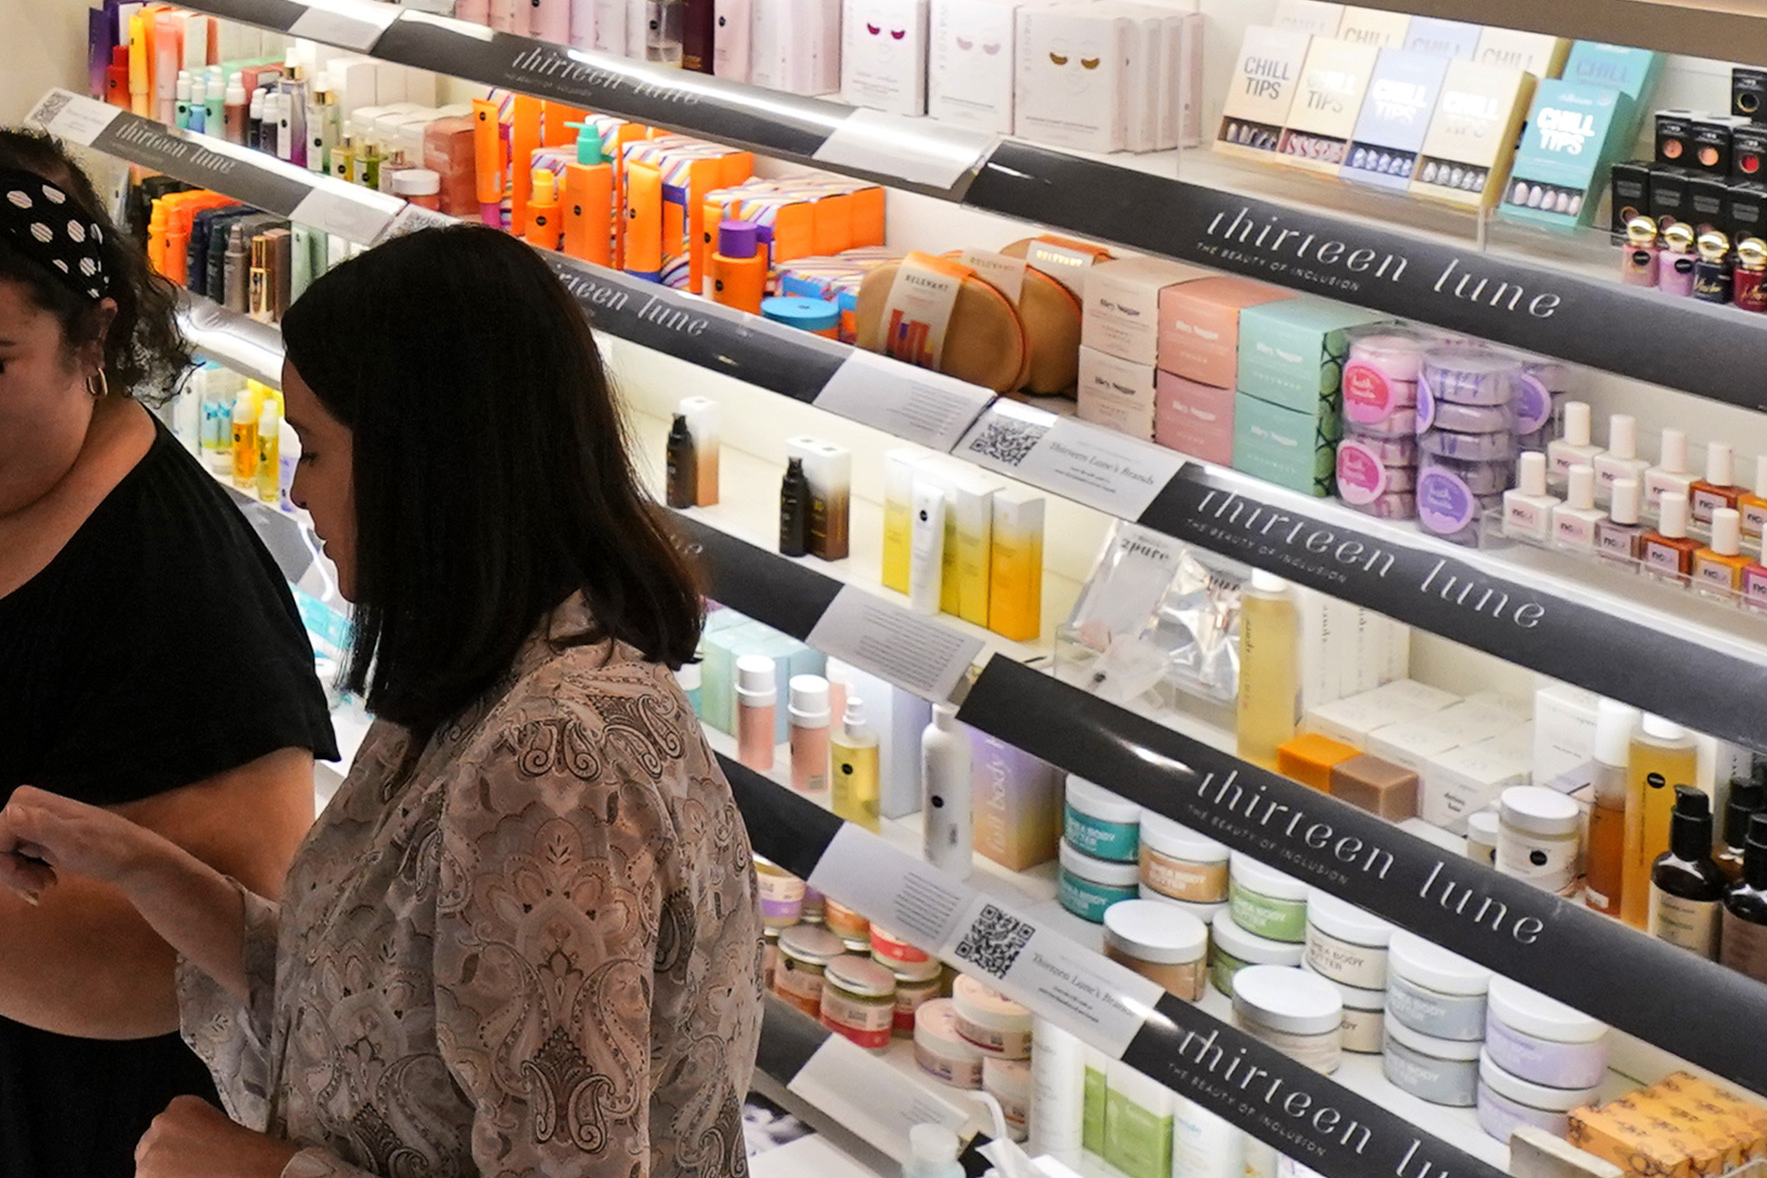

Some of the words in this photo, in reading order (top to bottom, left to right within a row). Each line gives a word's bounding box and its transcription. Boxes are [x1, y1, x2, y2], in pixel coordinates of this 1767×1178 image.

[512, 47, 624, 89] thirteen
[1244, 56, 1290, 80] CHILL
[1245, 77, 1281, 99] TIPS
[1307, 70, 1356, 95] CHILL
[1307, 90, 1343, 113] TIPS
[1373, 79, 1426, 107] CHILL
[1375, 101, 1416, 125] TIPS
[1443, 91, 1498, 120] CHILL
[1537, 107, 1595, 137] CHILL
[1540, 129, 1584, 155] TIPS
[116, 121, 188, 158] thirteen
[190, 147, 237, 173] lune
[905, 274, 949, 292] RELEVANT
[1196, 242, 1217, 255] THE
[1220, 249, 1266, 268] BEAUTY
[1270, 261, 1287, 272] OF
[1291, 267, 1361, 292] INCLUSION
[1207, 207, 1408, 282] thirteen
[1434, 259, 1561, 318] lune
[556, 263, 629, 310] rteen
[638, 295, 709, 336] lune
[1188, 518, 1209, 533] THE
[1210, 527, 1255, 549] BEAUTY
[1258, 544, 1275, 556] OF
[1279, 553, 1348, 583] INCLUSION
[1197, 489, 1396, 578] thirteen
[1420, 559, 1546, 628] lune
[1186, 804, 1209, 820] THE
[1212, 816, 1257, 842] BEAUTY
[1260, 838, 1277, 851] OF
[1281, 848, 1350, 886] INCLUSION
[1197, 770, 1395, 880] thirteen
[1420, 860, 1544, 945] lune
[1168, 1062, 1189, 1079] THE
[1191, 1076, 1235, 1106] BEAUTY
[1238, 1102, 1256, 1117] OF
[1260, 1115, 1327, 1157] INCLUSION
[1178, 1030, 1373, 1155] thirteen
